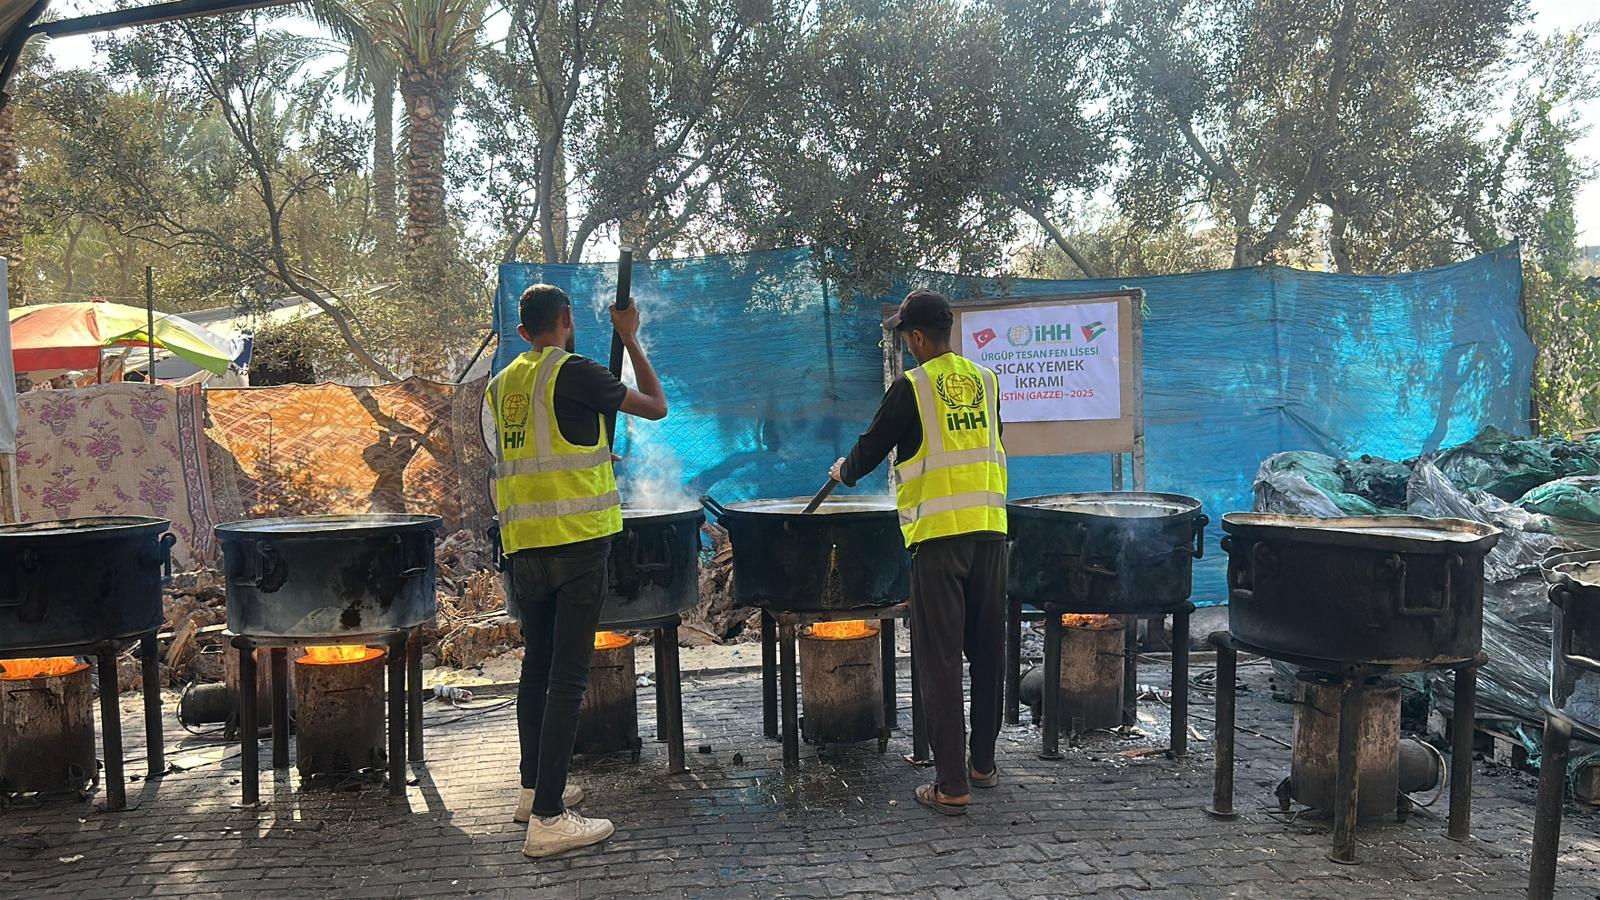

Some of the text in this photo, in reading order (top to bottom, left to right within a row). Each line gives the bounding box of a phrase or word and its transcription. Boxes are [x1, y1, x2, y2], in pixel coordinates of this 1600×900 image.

[1035, 324, 1071, 341] iHH
[981, 351, 1014, 361] ÜRGÜP
[1016, 350, 1047, 359] TESAN
[1049, 349, 1067, 358] FEN
[995, 360, 1084, 375] SICAK YEMEK
[1015, 375, 1064, 388] İKRAMI
[1000, 390, 1025, 400] İSTİN
[1027, 390, 1064, 400] (GAZZE)
[1071, 389, 1094, 398] 2025
[947, 411, 987, 431] iHH
